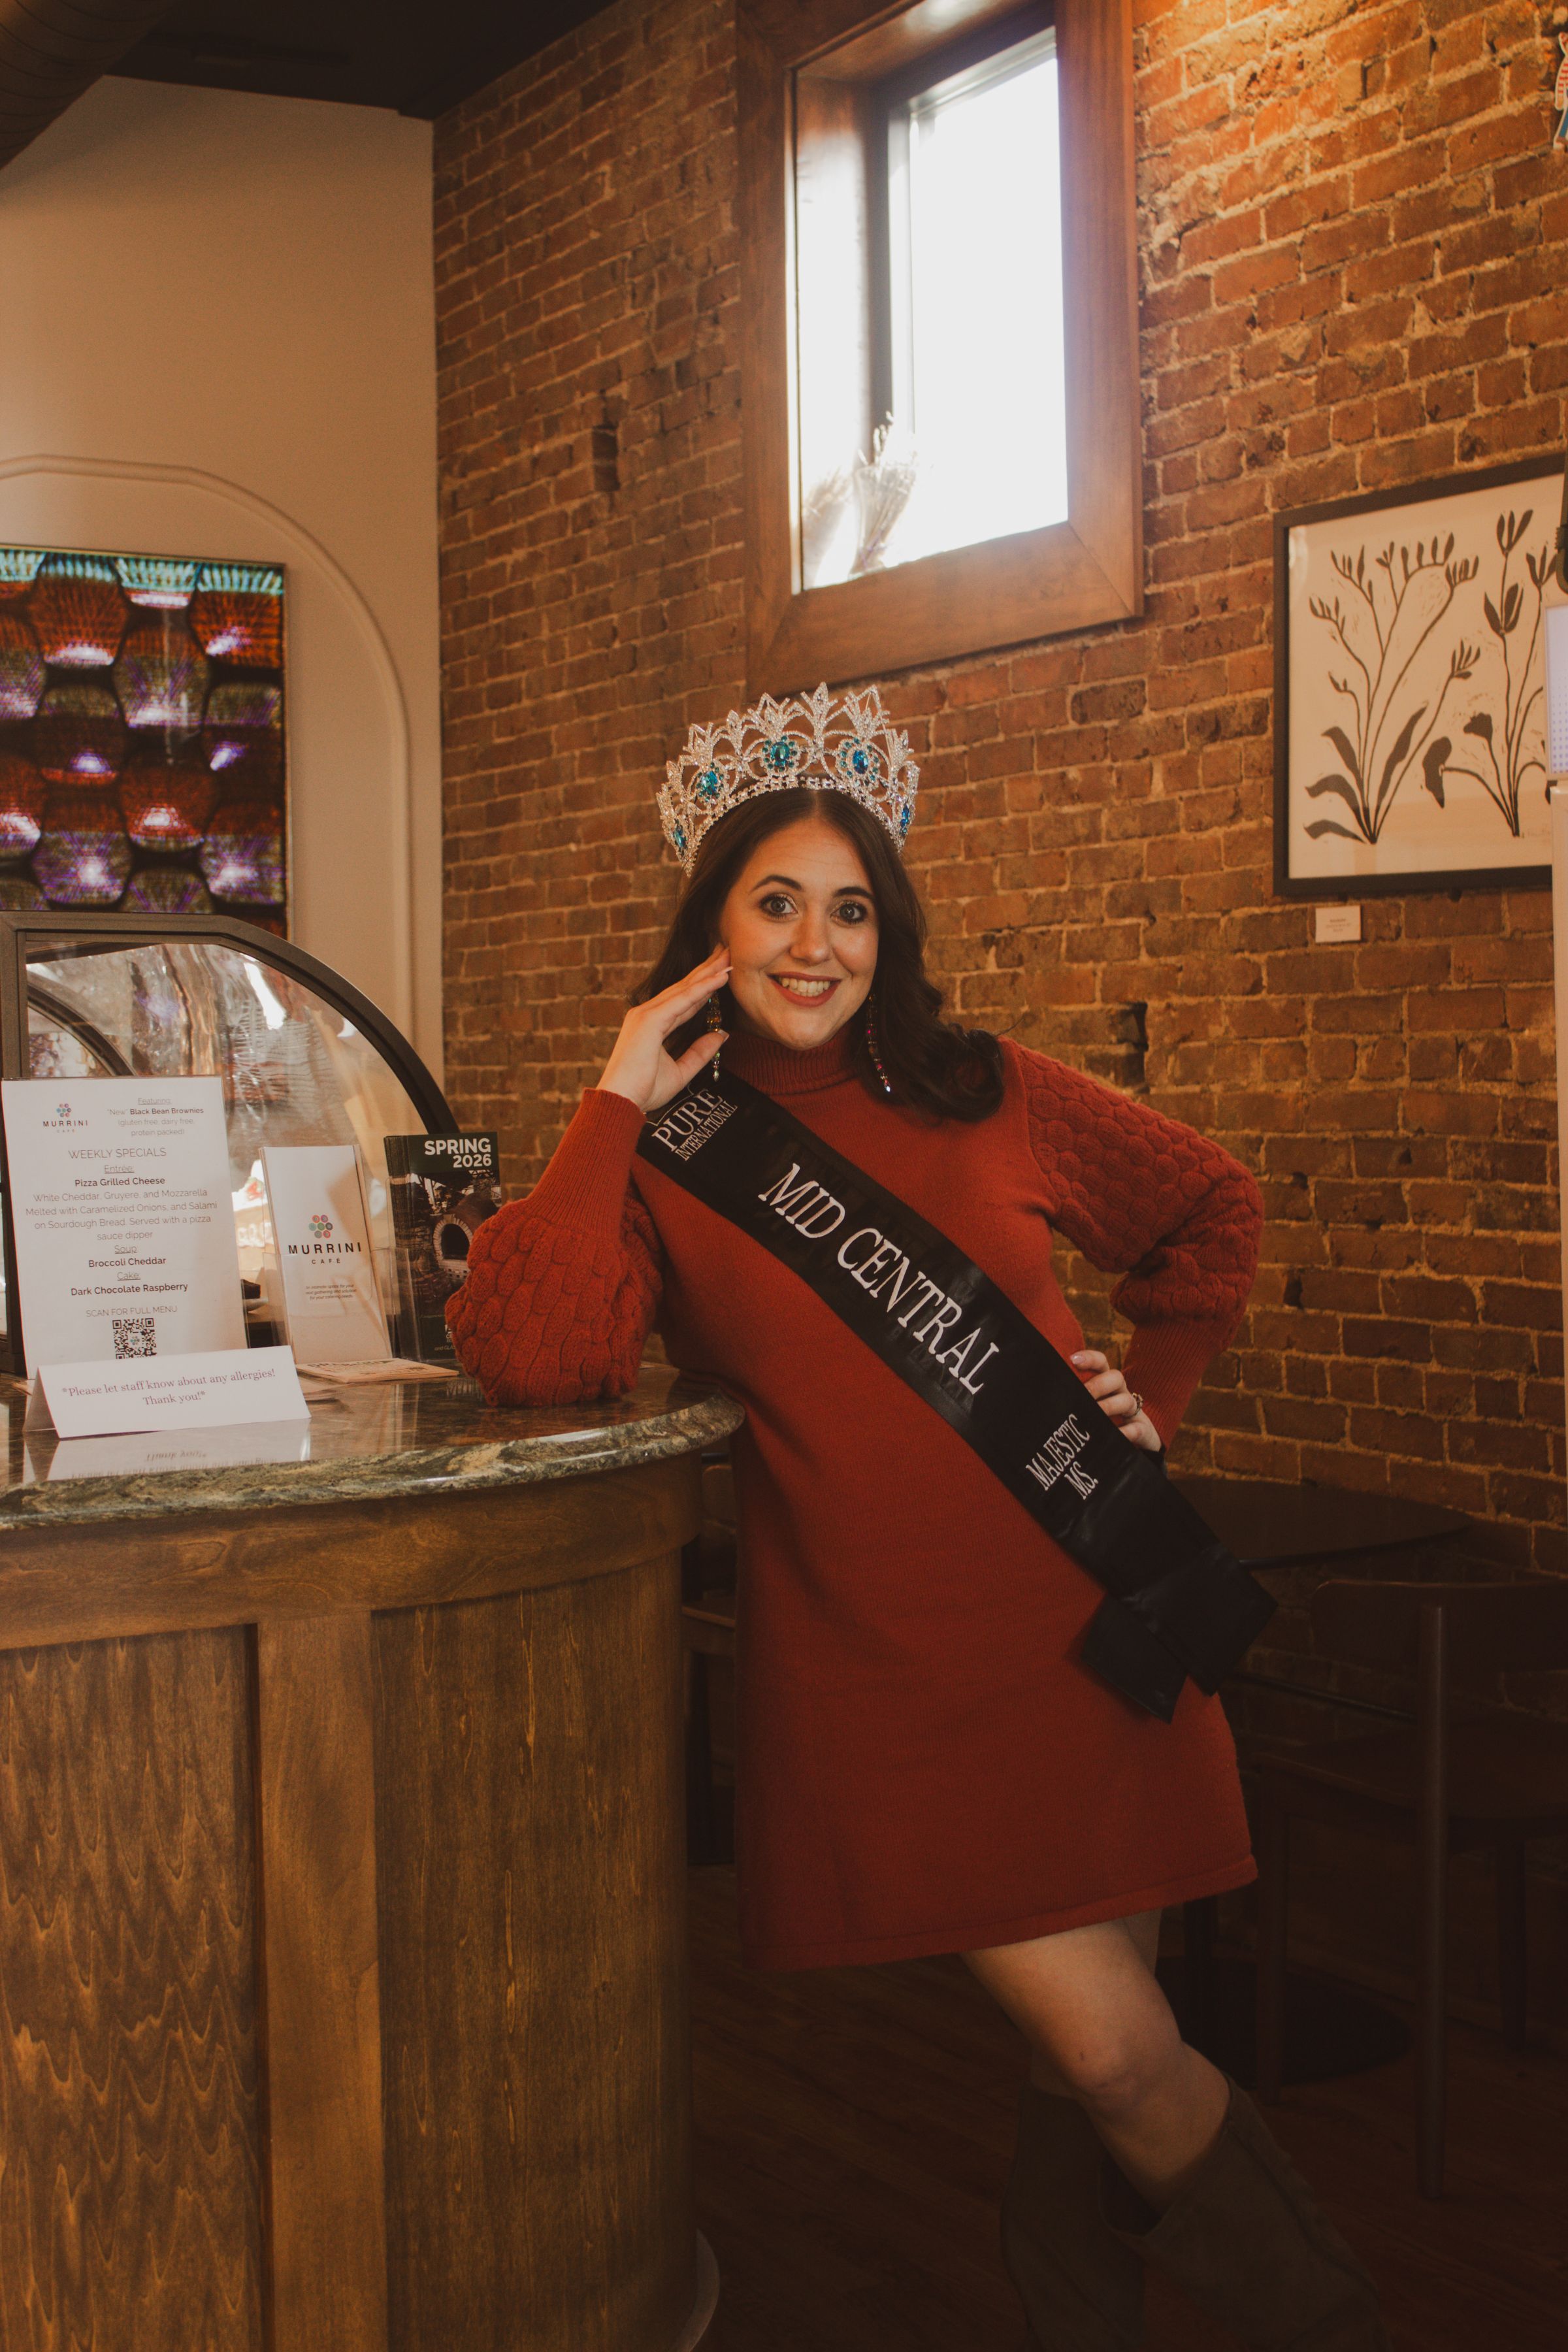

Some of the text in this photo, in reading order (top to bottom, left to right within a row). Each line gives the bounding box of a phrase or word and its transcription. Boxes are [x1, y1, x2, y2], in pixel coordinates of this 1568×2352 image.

[651, 1088, 724, 1152] PURE
[675, 1100, 738, 1162] INTERNATIONAL
[68, 1147, 167, 1159] WEEKLY SPECIALS
[425, 1138, 491, 1155] SPRING
[453, 1154, 492, 1168] 2026
[75, 1179, 97, 1187] Pizza
[133, 1177, 165, 1185] Cheese
[33, 1193, 59, 1201] White
[143, 1190, 159, 1198] and
[161, 1188, 208, 1198] Mozzarella
[26, 1207, 57, 1216] Melted
[59, 1207, 78, 1215] with
[80, 1204, 135, 1214] Caramelized
[189, 1201, 218, 1209] Salami
[48, 1219, 97, 1230] Sourdough
[130, 1217, 160, 1226] Served
[162, 1216, 180, 1224] with
[189, 1215, 211, 1225] pizza
[125, 1231, 153, 1241] dipper
[288, 1242, 361, 1254] MURRINI
[89, 1257, 166, 1267] Broccoli Cheddar
[757, 1162, 1000, 1395] MID CENTRAL
[71, 1283, 188, 1296] Dark Chocolate Raspberry
[86, 1309, 109, 1317] SCAN
[130, 1307, 151, 1315] FULL
[153, 1305, 177, 1314] MENU
[105, 1381, 118, 1394] let
[121, 1379, 146, 1392] staff
[146, 1378, 175, 1390] know
[177, 1375, 207, 1387] about
[209, 1374, 228, 1385] any
[230, 1368, 276, 1383] allergies!
[143, 1394, 176, 1406] Thank
[1026, 1413, 1090, 1492] MAJESTIC
[1064, 1461, 1099, 1501] MS.
